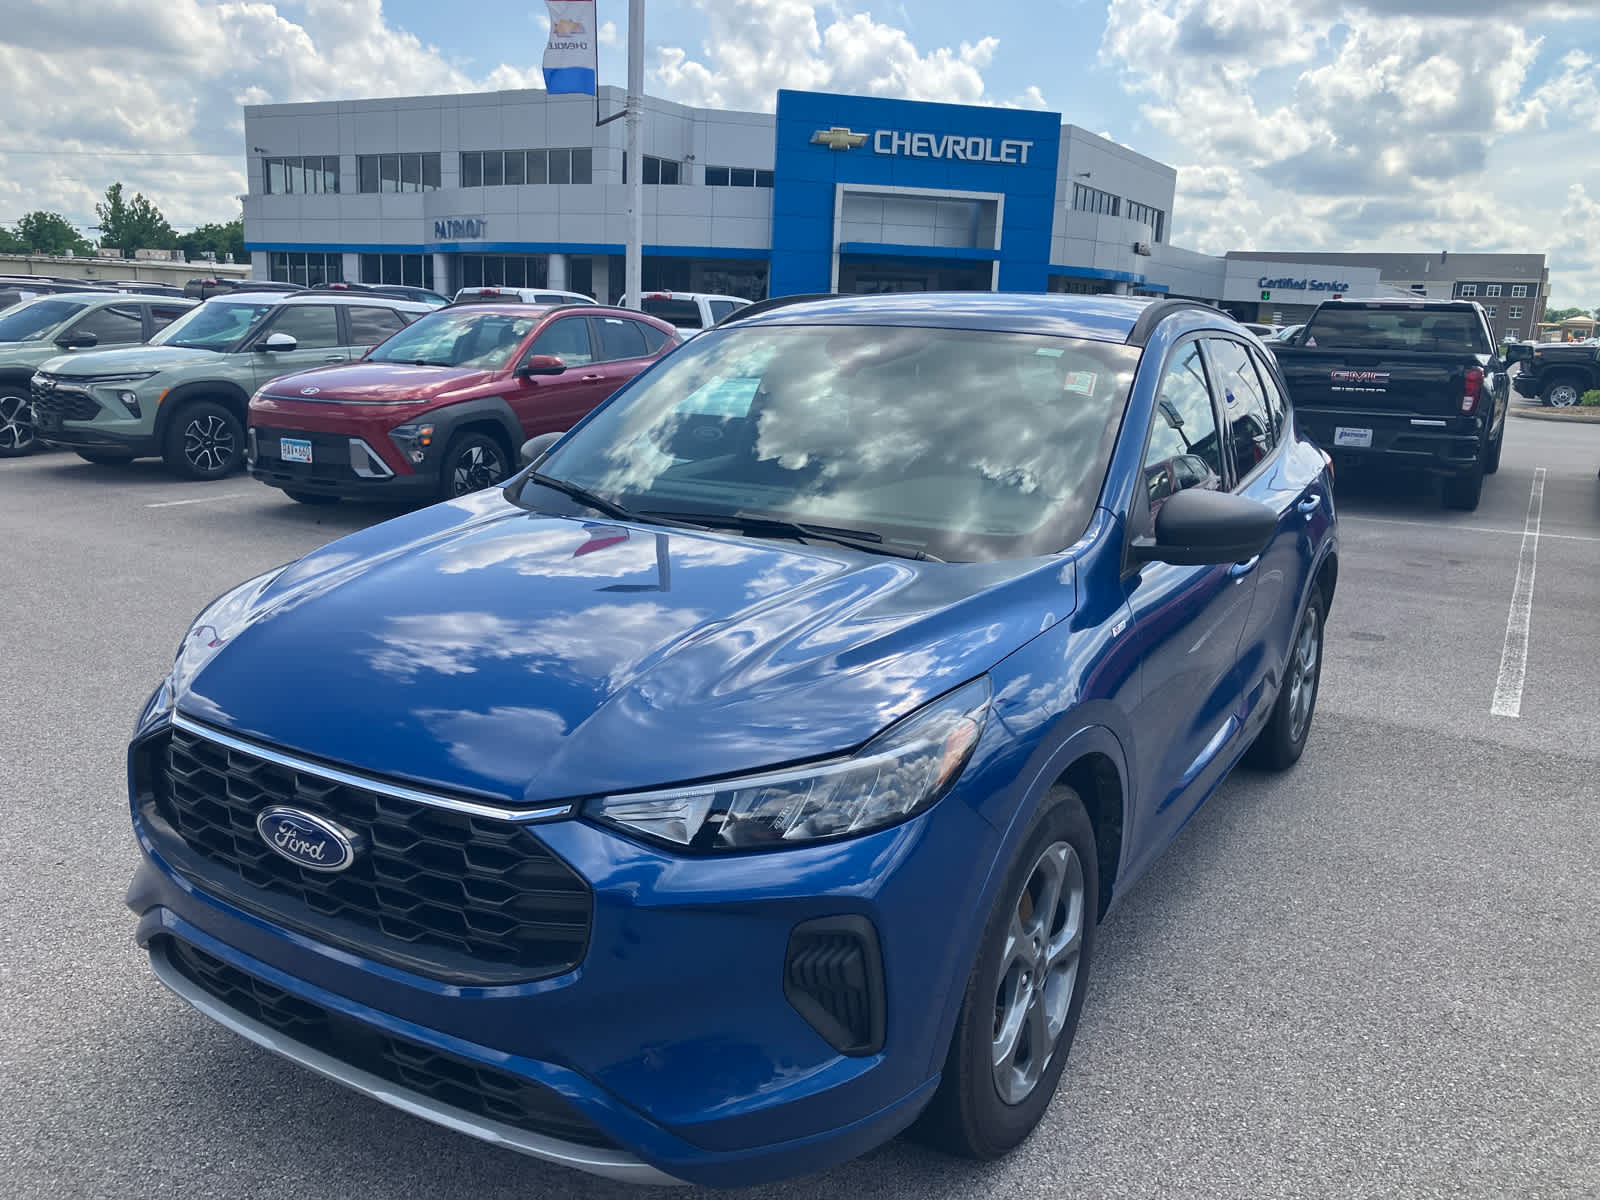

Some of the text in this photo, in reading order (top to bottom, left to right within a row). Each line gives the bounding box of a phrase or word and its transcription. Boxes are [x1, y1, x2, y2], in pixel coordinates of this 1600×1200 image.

[873, 129, 1034, 164] CHEVROLET
[434, 218, 488, 240] PATRIOT
[1258, 276, 1350, 292] Certified Service
[1331, 370, 1390, 384] GMC
[274, 819, 326, 860] Ford
